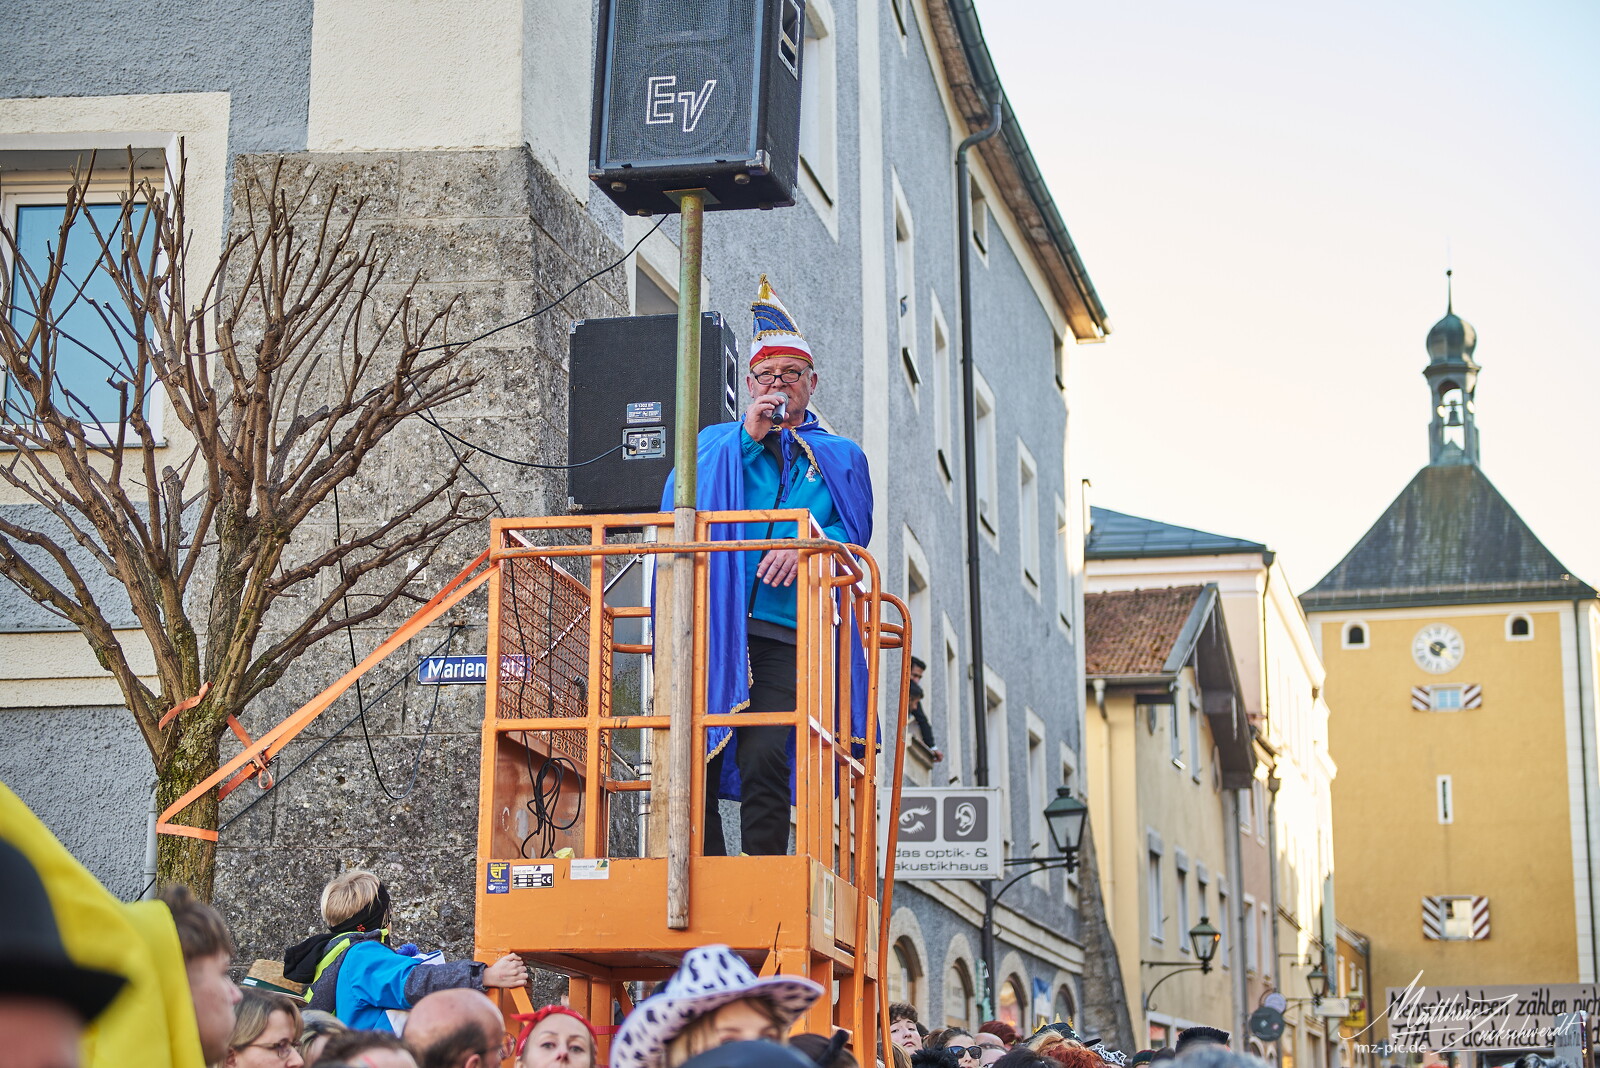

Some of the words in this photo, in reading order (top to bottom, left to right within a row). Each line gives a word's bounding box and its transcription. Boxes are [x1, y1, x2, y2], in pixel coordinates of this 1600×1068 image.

[427, 659, 526, 679] Marienatz
[925, 847, 971, 859] optik-
[975, 847, 989, 858] &
[894, 861, 989, 871] akustikhaus
[1515, 987, 1567, 1016] zählen
[1441, 1024, 1457, 1048] is
